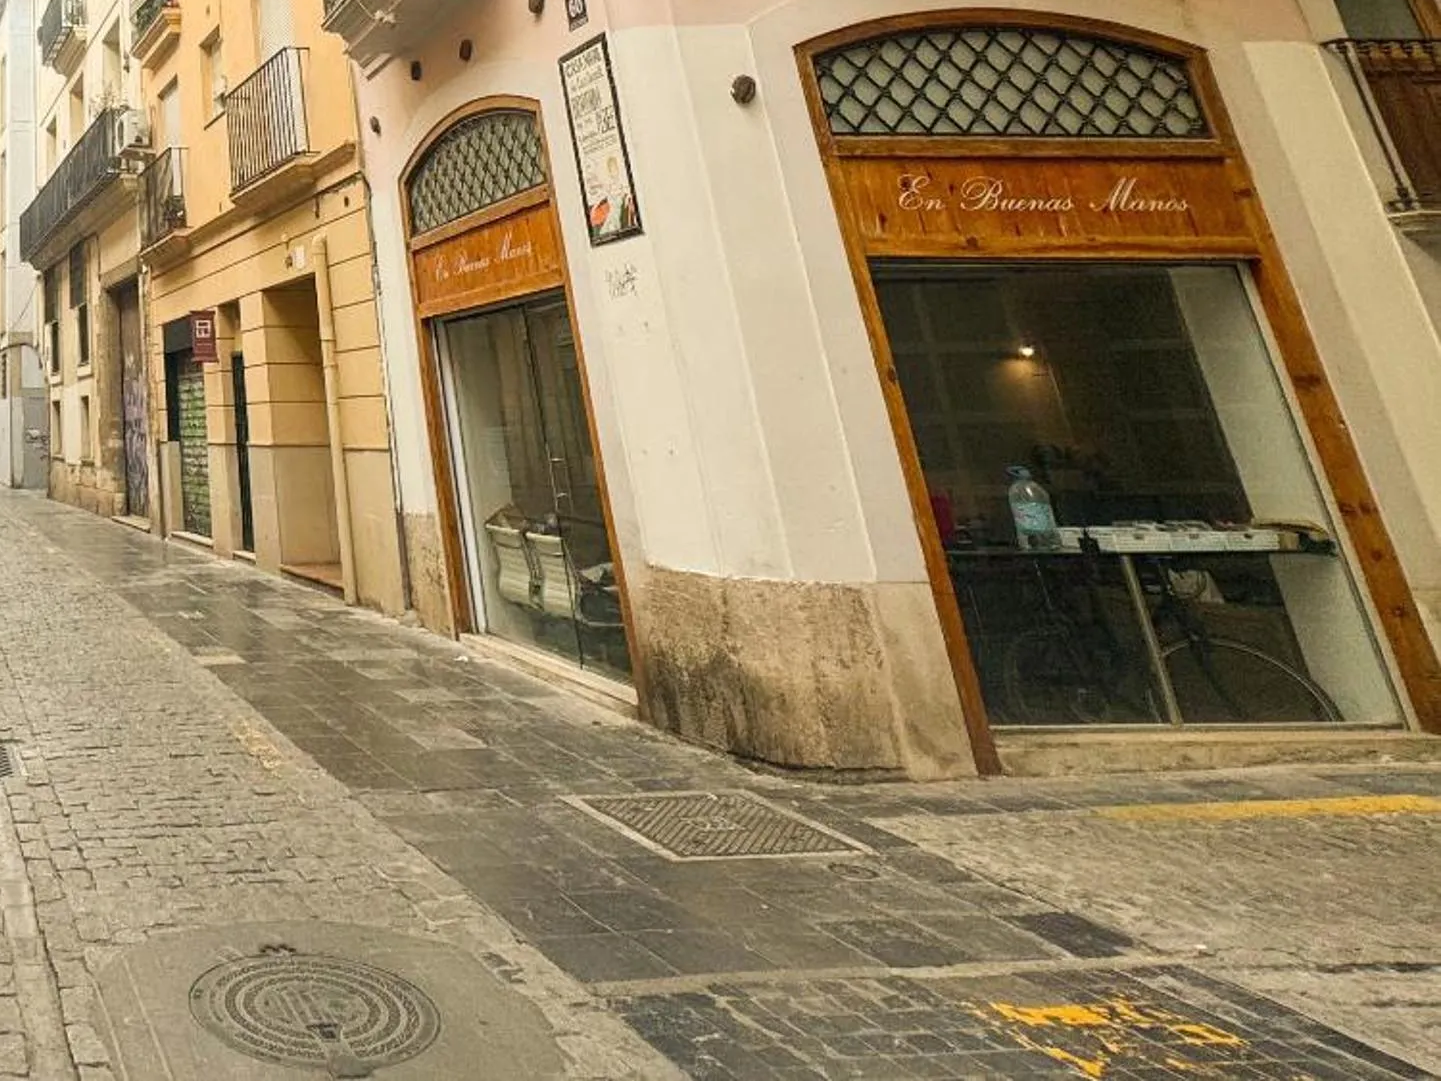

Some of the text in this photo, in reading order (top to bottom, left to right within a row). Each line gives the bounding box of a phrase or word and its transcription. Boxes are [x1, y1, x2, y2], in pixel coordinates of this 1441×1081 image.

[897, 173, 1190, 212] En Buenas Manos
